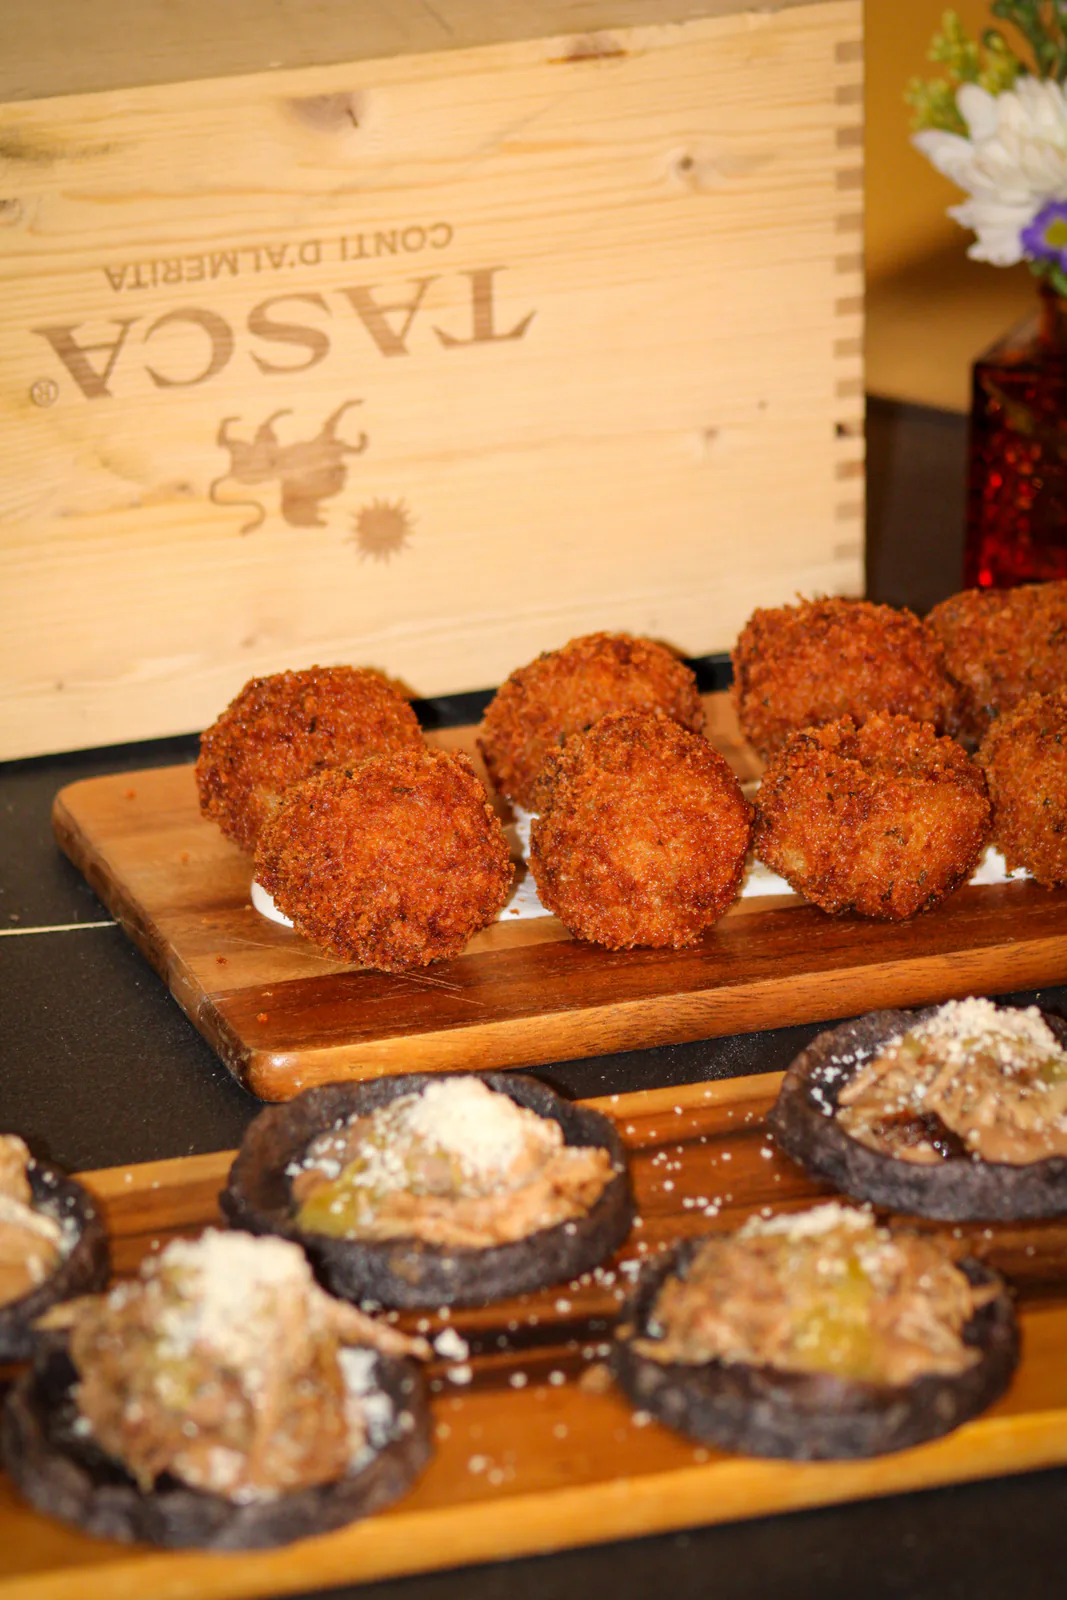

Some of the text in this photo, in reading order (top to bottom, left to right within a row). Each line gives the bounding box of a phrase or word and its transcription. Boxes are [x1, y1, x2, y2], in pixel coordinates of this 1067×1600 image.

[104, 222, 453, 292] CONTI D'ALMERITA
[31, 266, 536, 400] TASCA
